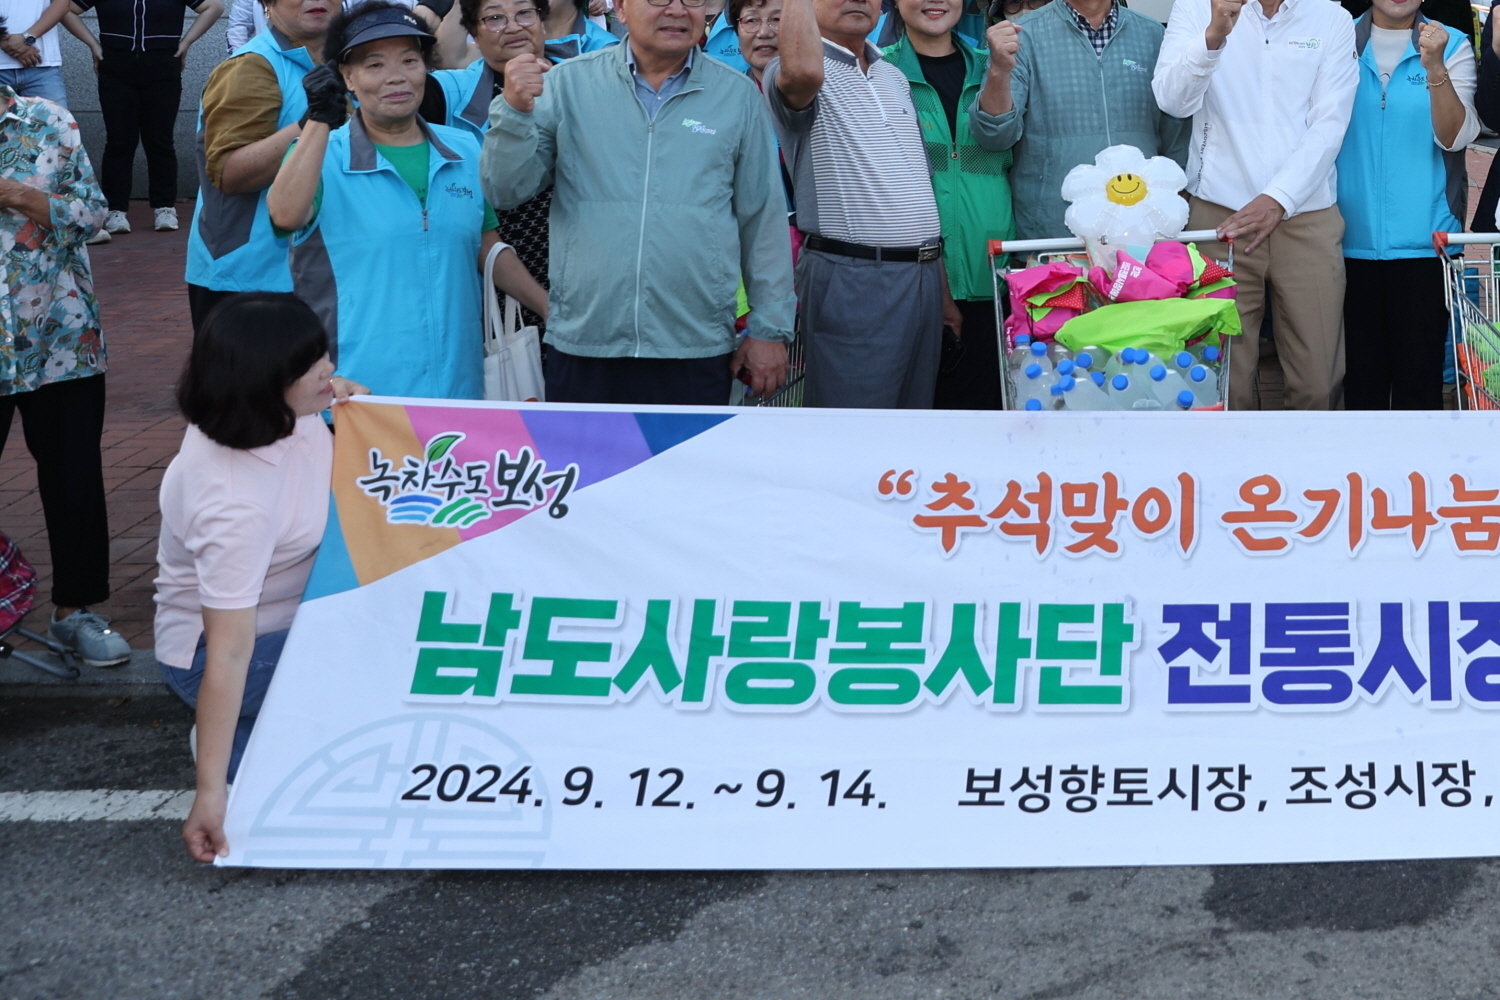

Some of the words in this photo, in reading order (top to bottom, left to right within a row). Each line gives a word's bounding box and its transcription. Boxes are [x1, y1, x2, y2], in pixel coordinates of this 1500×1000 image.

[360, 451, 490, 501] 녹차수도
[491, 449, 577, 519] 보성
[878, 470, 1201, 555] “추석맞이
[410, 590, 1134, 705] 남도사랑봉사단
[401, 764, 543, 807] 2024.
[562, 766, 603, 808] 9.
[629, 767, 694, 809] 12.
[820, 769, 887, 809] 14.
[958, 764, 1267, 814] 보성향토시장,
[1285, 760, 1493, 810] 조성시장,
